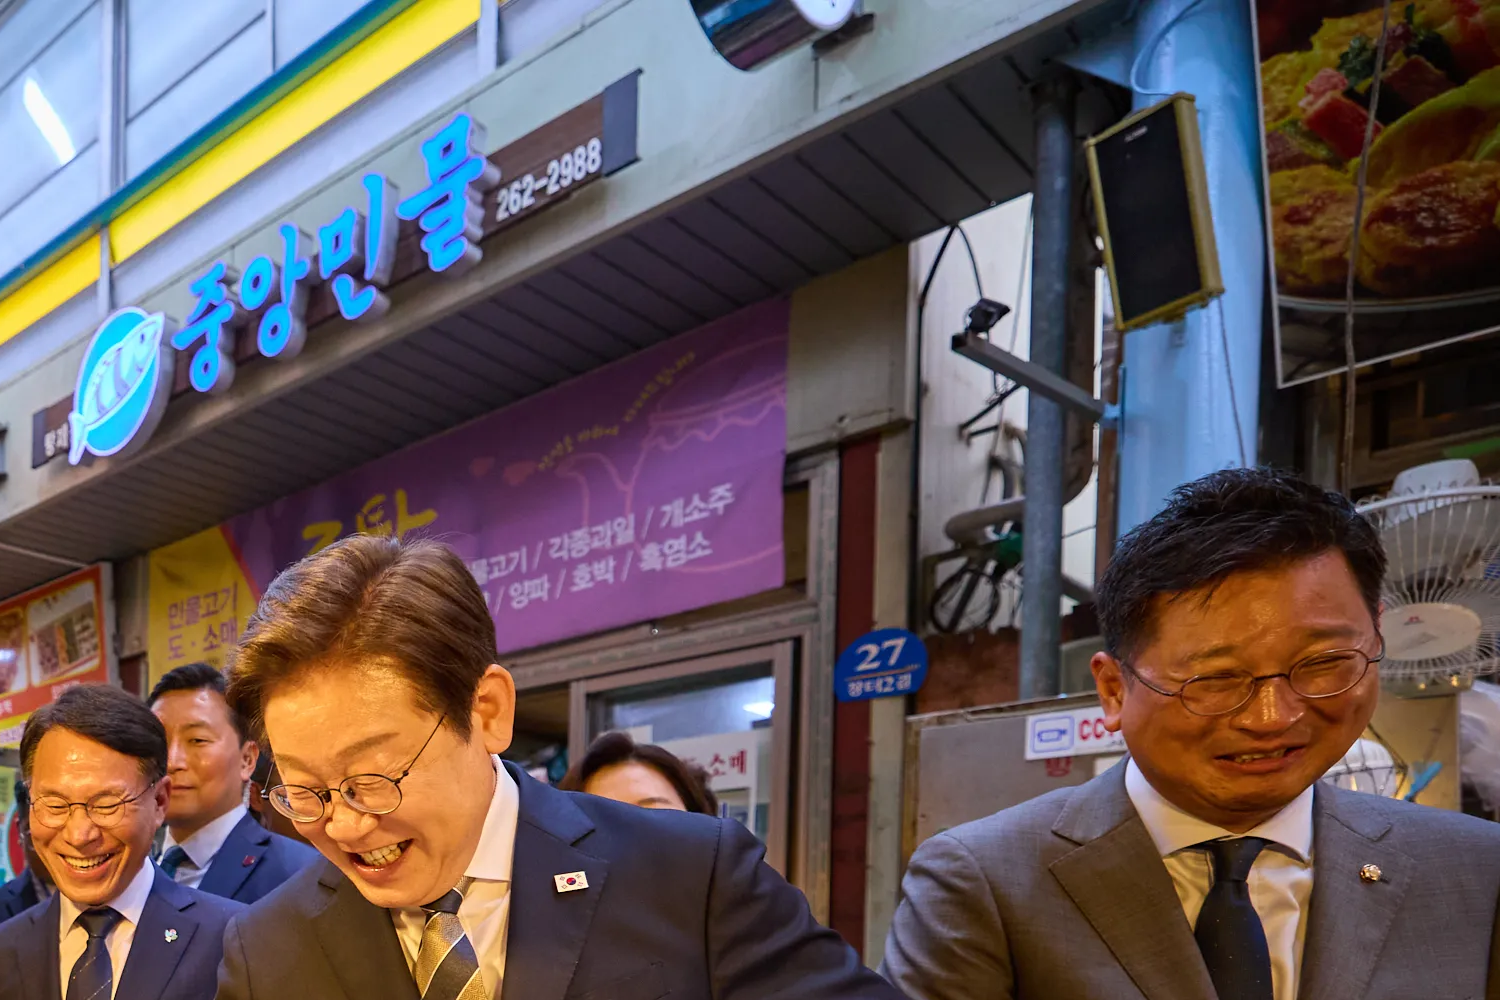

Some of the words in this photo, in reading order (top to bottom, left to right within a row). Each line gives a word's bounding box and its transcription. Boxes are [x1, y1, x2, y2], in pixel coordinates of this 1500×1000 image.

[496, 137, 603, 222] 262-2988
[173, 113, 486, 392] 중앙민물
[549, 513, 636, 561] 각종과일
[660, 483, 735, 529] 개소주
[167, 581, 238, 631] 민물고기
[508, 574, 551, 610] 양파
[569, 554, 616, 593] 호박
[639, 530, 713, 572] 흑염소
[853, 636, 908, 673] 27
[1078, 717, 1115, 741] CC
